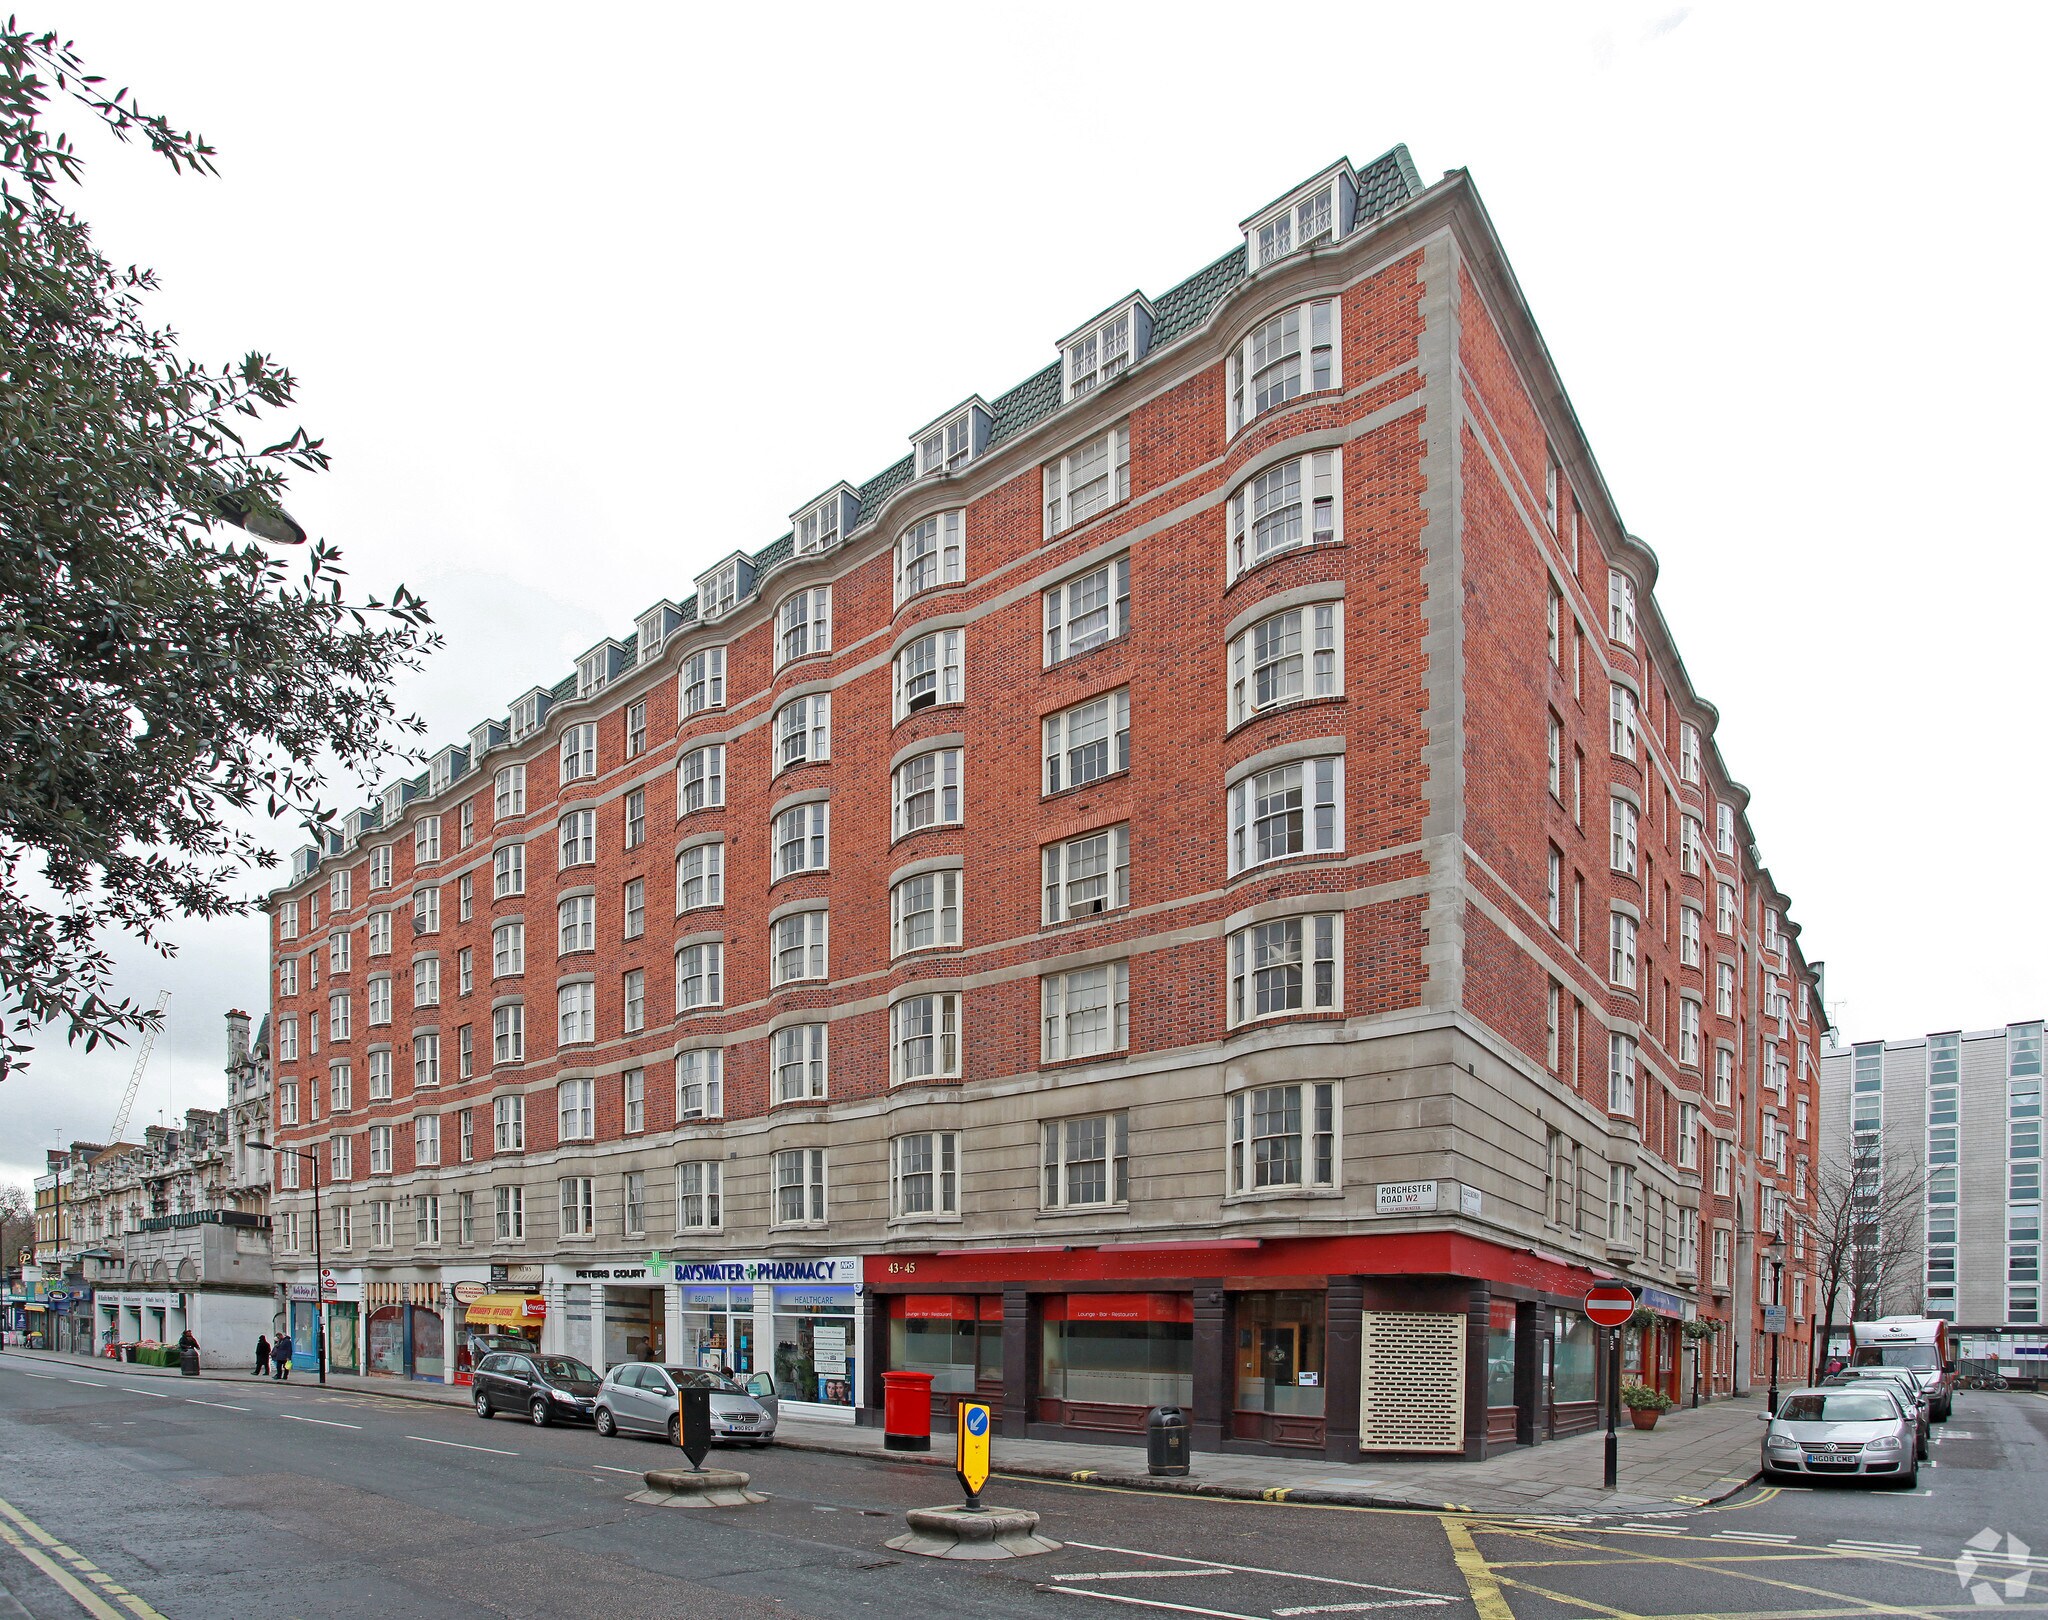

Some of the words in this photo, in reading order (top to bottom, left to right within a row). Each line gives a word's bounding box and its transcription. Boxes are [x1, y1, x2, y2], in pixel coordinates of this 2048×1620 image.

[1381, 1184, 1432, 1195] PORCHESTER
[1381, 1195, 1402, 1204] ROAD
[1405, 1194, 1418, 1202] W2
[841, 1261, 854, 1269] NHS
[576, 1270, 609, 1279] PETERS
[613, 1269, 646, 1279] COURT
[675, 1264, 744, 1281] BAYSWATER
[757, 1261, 836, 1281] PHARMACY
[794, 1296, 833, 1304] HEALTHCARE
